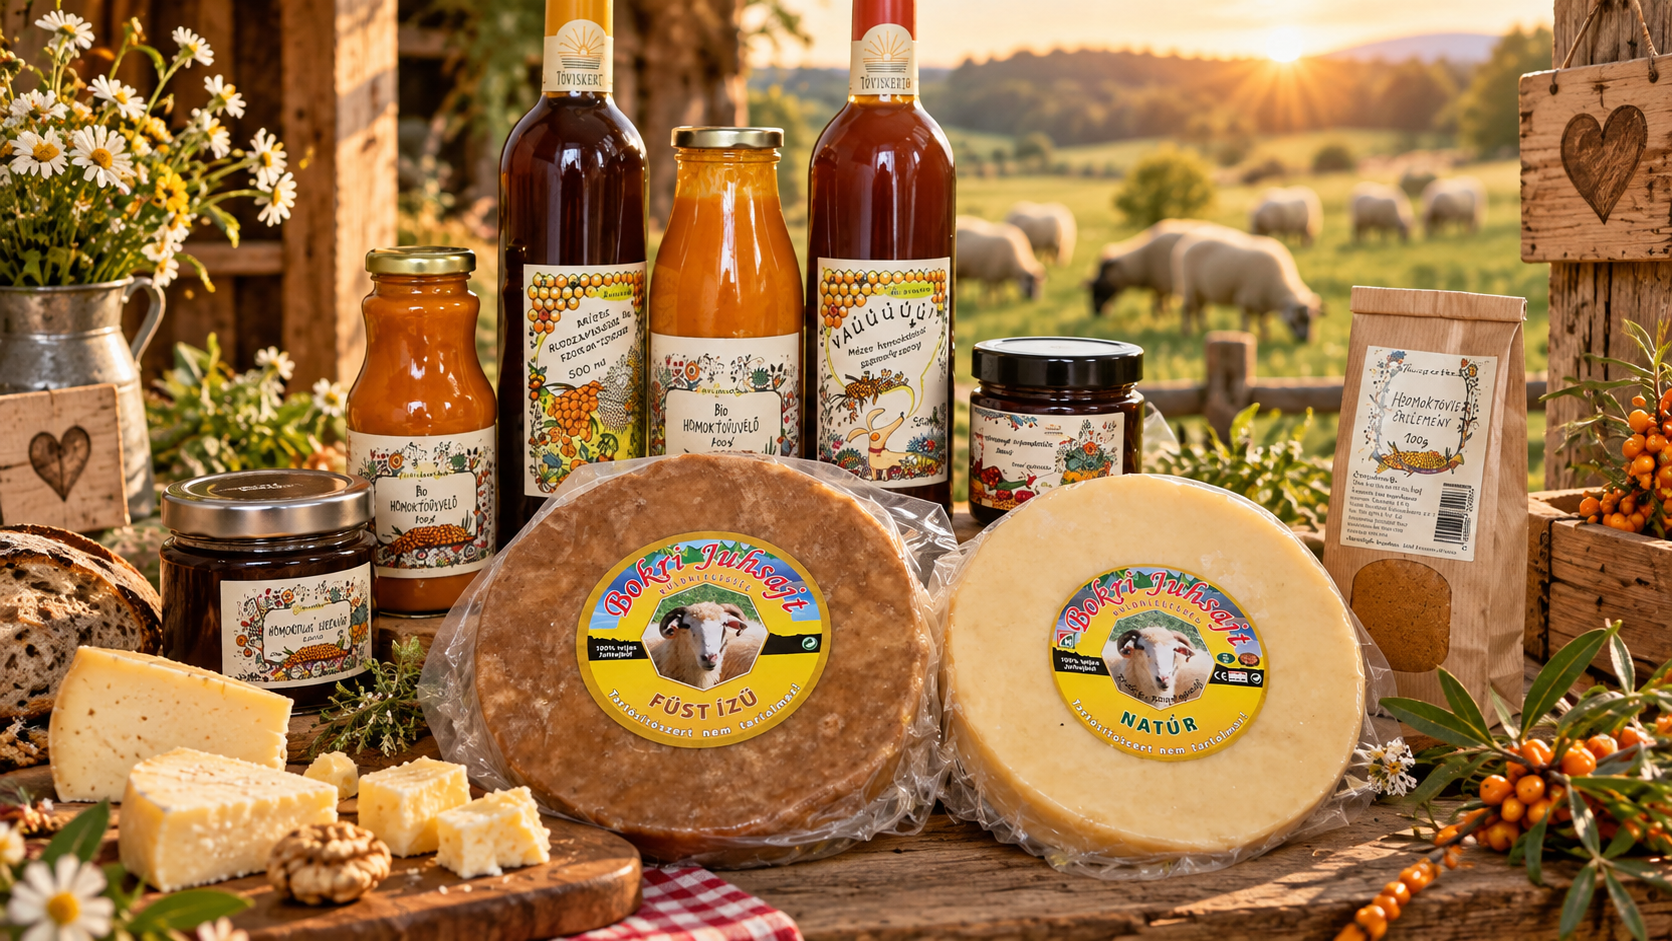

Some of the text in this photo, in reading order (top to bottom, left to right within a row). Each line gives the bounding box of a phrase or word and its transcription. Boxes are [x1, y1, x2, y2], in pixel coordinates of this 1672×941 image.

[714, 403, 729, 417] Bio
[603, 542, 810, 617] Bokri Juhsajt
[1064, 570, 1252, 648] Bokri Juhsajt
[702, 726, 732, 738] nem
[1120, 711, 1199, 736] NATÚR
[1159, 746, 1186, 755] nem
